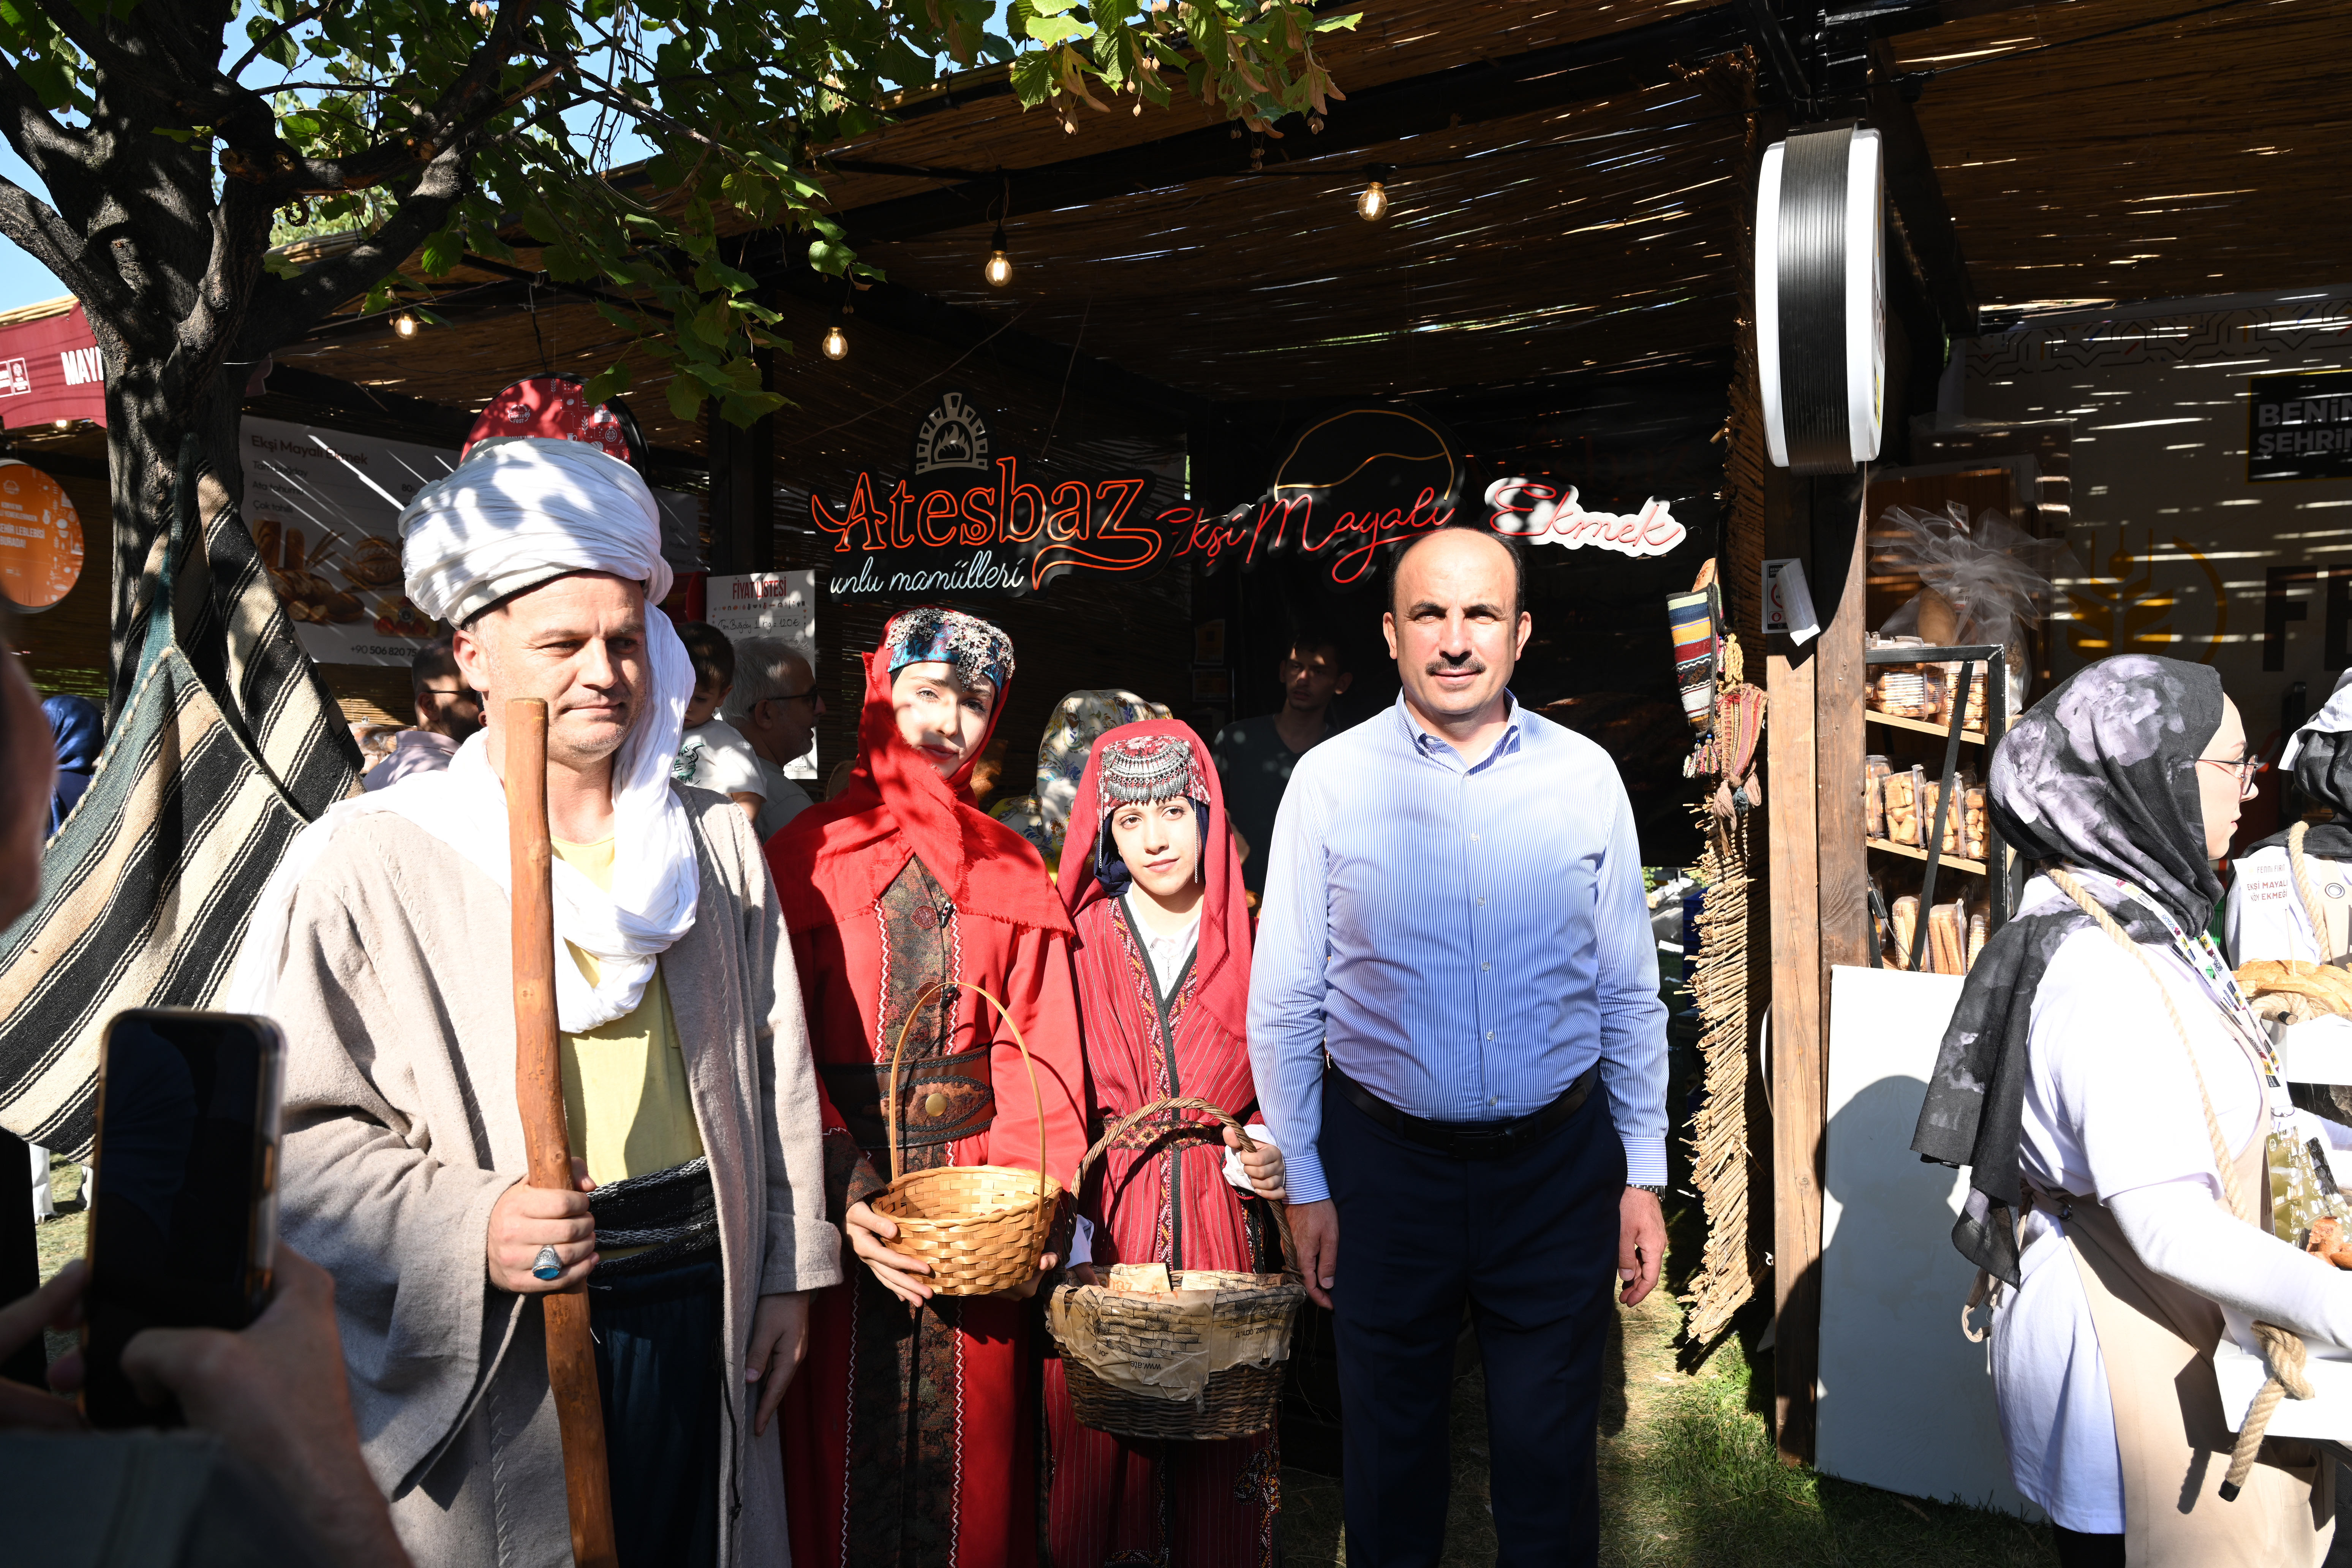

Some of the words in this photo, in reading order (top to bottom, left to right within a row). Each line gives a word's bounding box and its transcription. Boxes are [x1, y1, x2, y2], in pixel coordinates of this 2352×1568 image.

[251, 435, 277, 452] Ekşi
[280, 439, 322, 458] Mayalı
[326, 447, 368, 465] Ekmek
[275, 463, 308, 478] buğday
[252, 481, 267, 490] Ata
[253, 500, 270, 510] Çok
[812, 457, 1162, 590] Atesbaz
[1489, 483, 1681, 547] Ekmek
[1156, 507, 1246, 567] Ekşi
[1245, 487, 1456, 583] Mayalı
[830, 556, 884, 594] unlu
[889, 550, 1025, 591] mamülleri
[733, 580, 754, 600] FİYAT
[756, 576, 786, 598] LİSTESİ
[351, 645, 368, 654] +90
[370, 646, 387, 655] 506
[389, 647, 405, 656] 820
[407, 648, 417, 657] 75
[2247, 880, 2260, 891] EKŞİ
[2262, 879, 2288, 889] MAYALI
[2250, 892, 2259, 902] KÖY
[2261, 888, 2287, 900] EKMEĞİ
